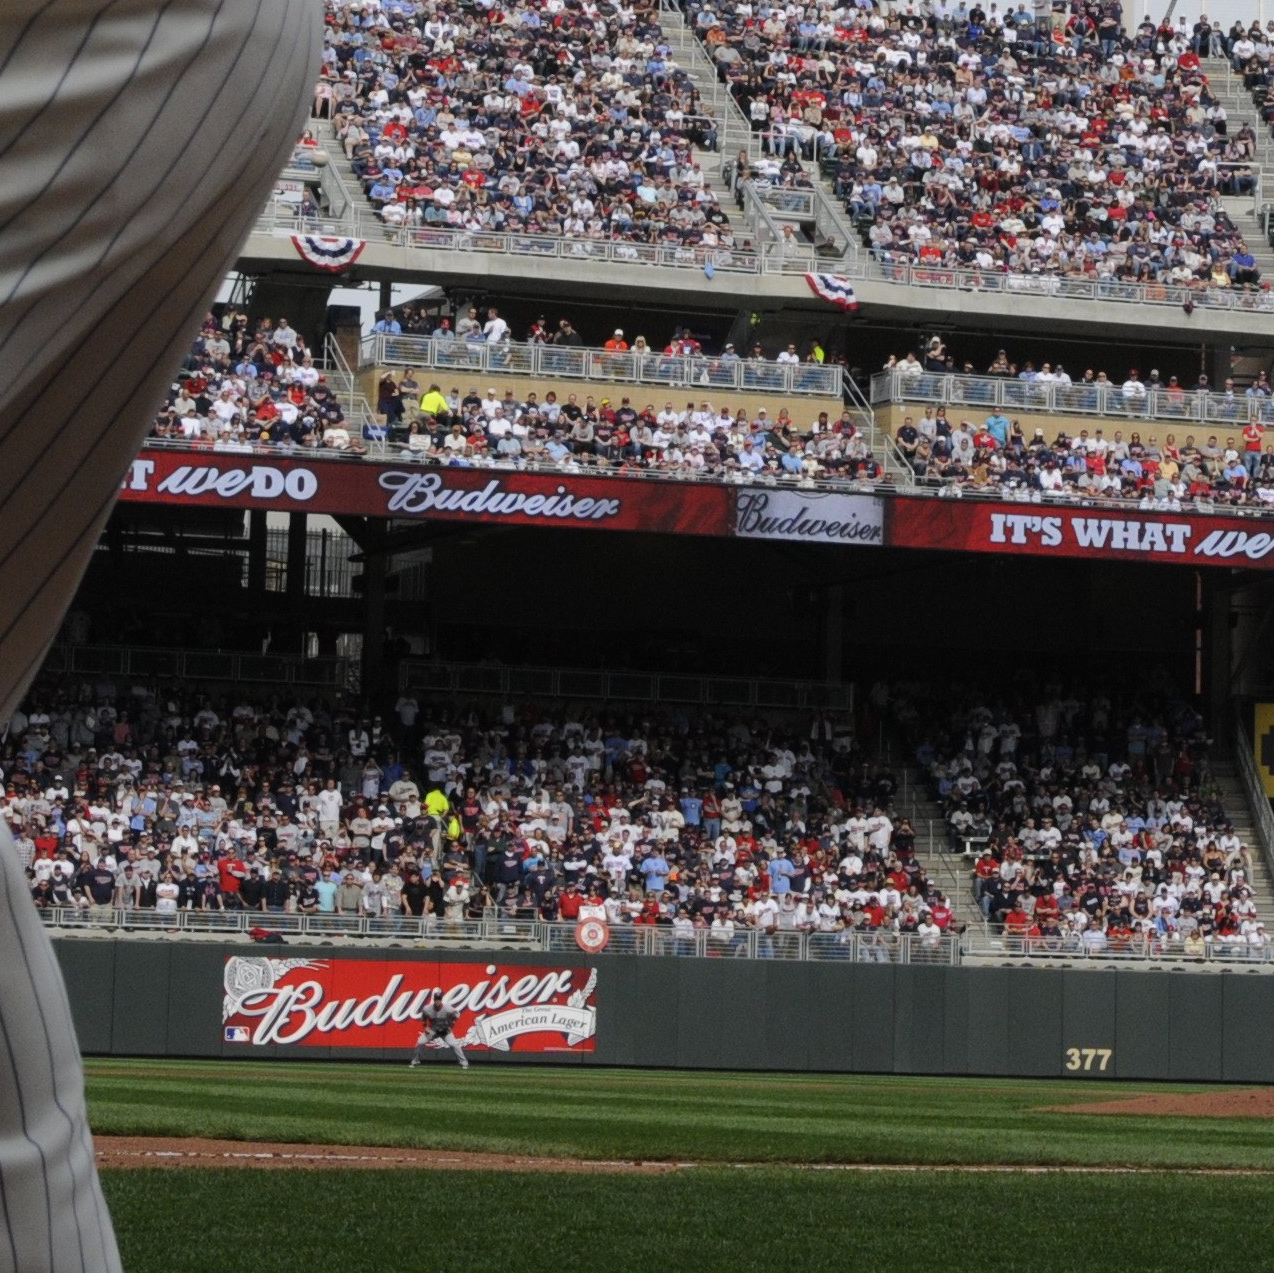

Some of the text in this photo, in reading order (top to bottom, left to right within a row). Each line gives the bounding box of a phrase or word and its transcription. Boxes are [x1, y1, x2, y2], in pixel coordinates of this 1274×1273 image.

[379, 472, 618, 518] Budweiser
[735, 492, 882, 544] Budweiser
[991, 514, 1062, 546] IT'S
[1071, 518, 1191, 552] WHAT
[239, 965, 572, 1045] Budweiser
[489, 1013, 586, 1037] American Lager
[1066, 1048, 1111, 1070] 377
